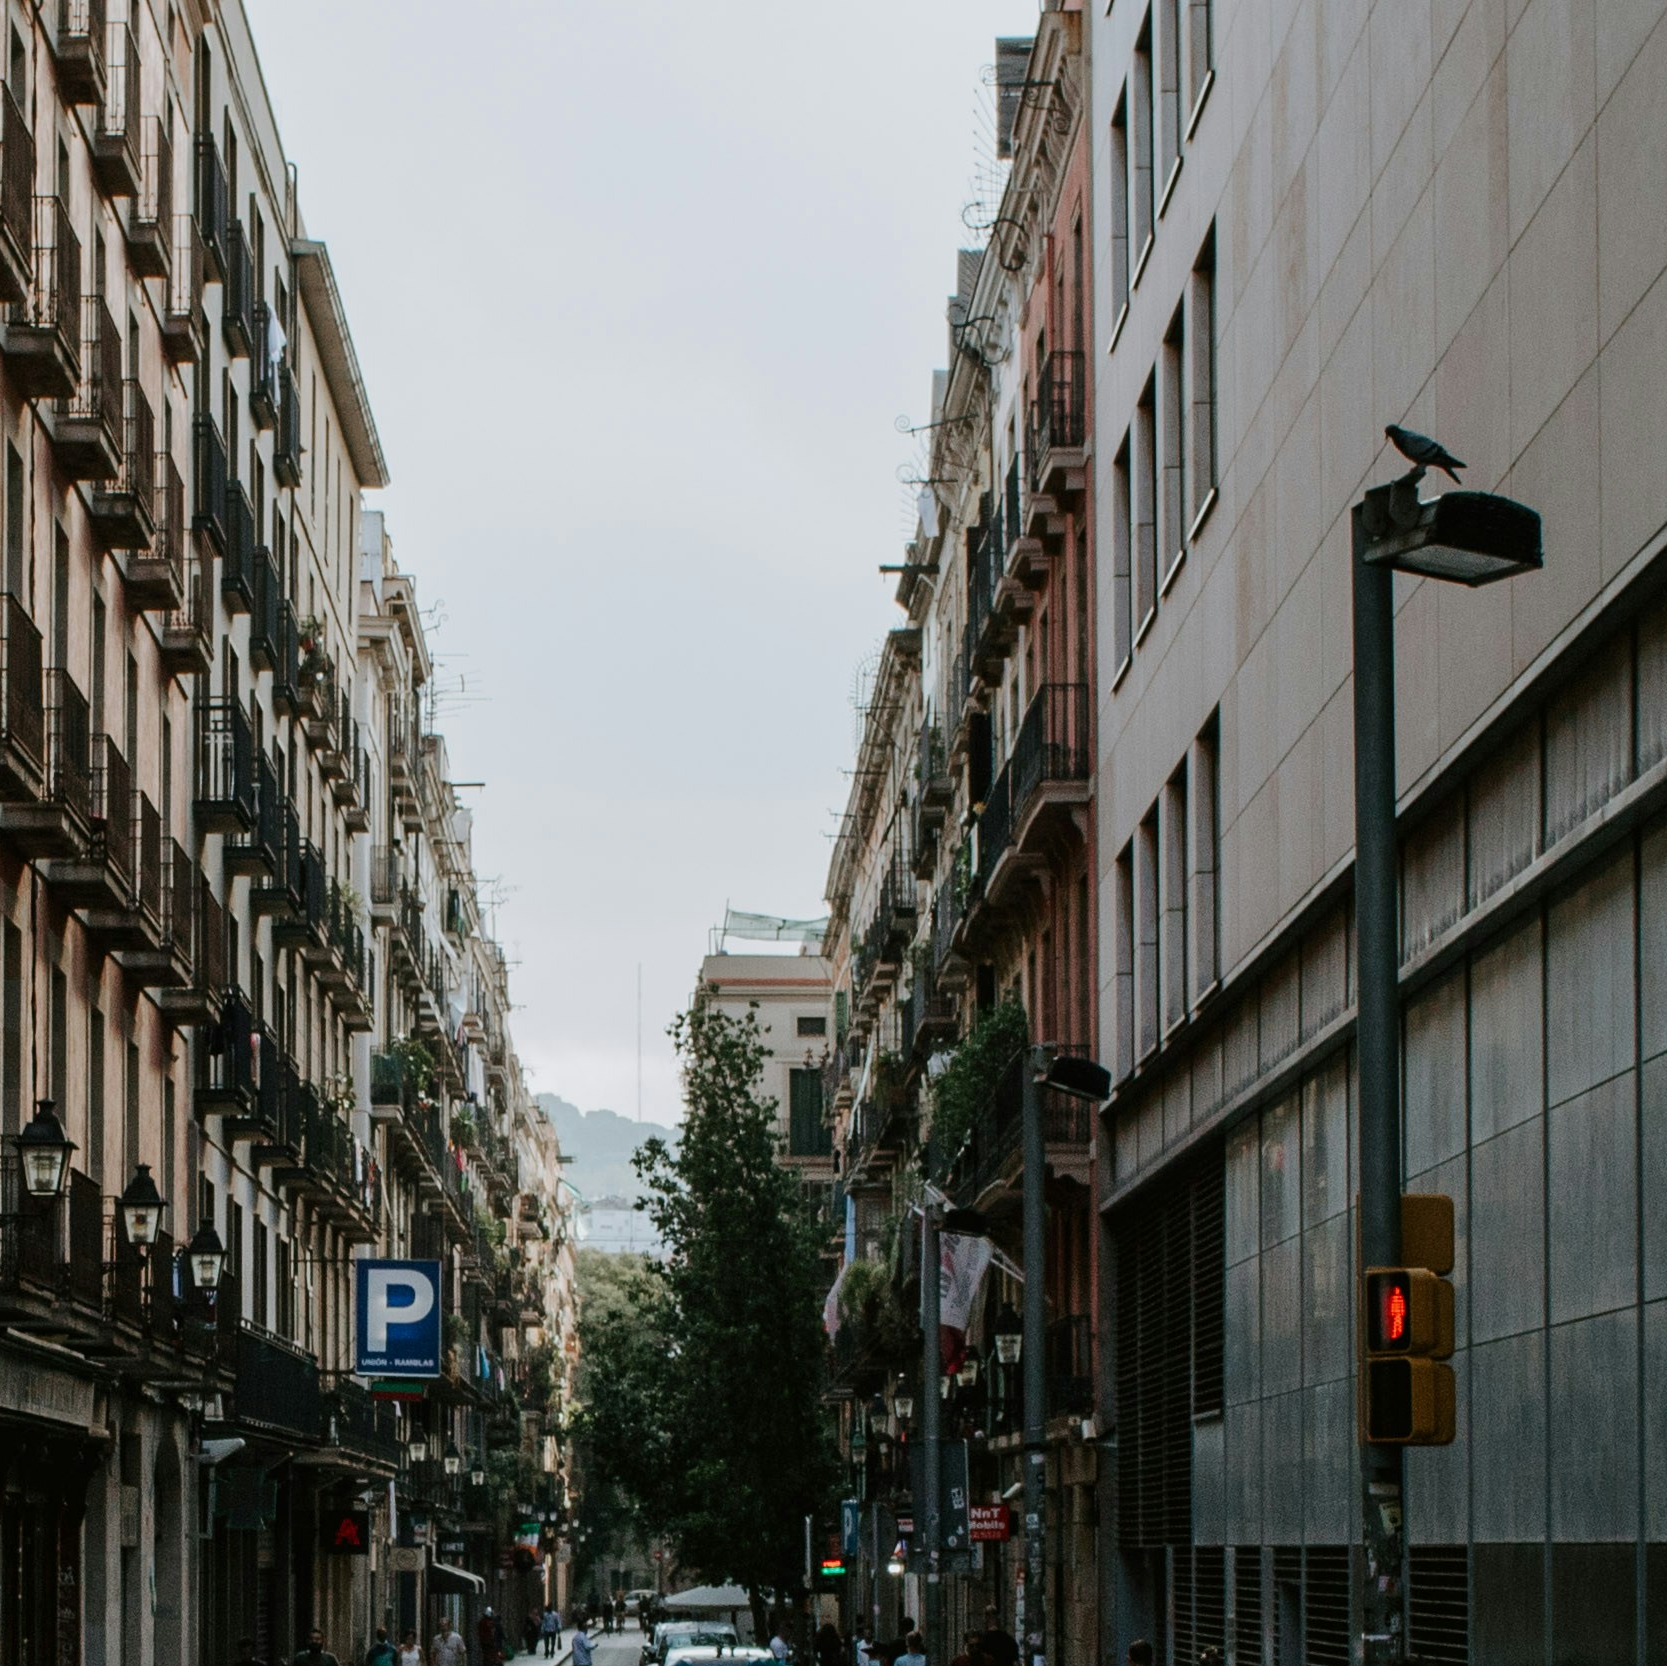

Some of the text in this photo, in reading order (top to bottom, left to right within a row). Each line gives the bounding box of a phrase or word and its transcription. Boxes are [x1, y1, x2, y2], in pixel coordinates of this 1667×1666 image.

[367, 1268, 434, 1352] P
[361, 1358, 387, 1367] UNIÓN
[395, 1358, 434, 1367] RAMBLAS
